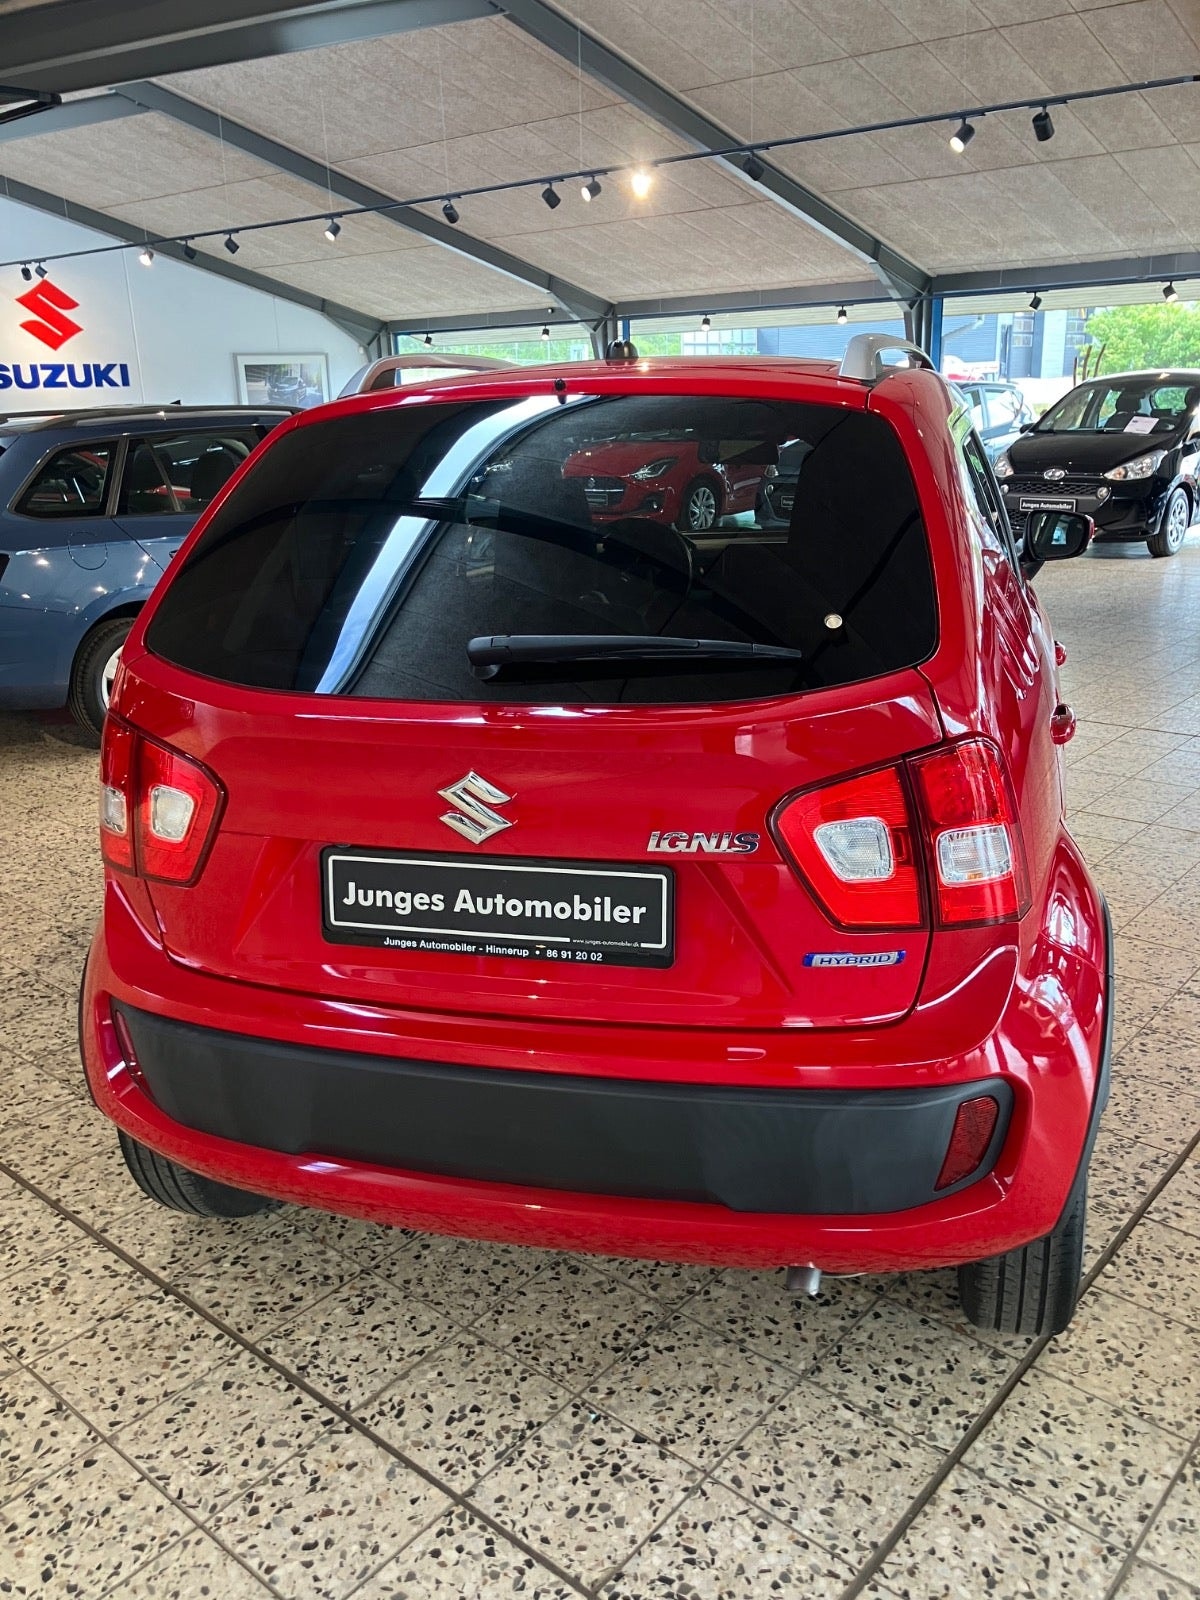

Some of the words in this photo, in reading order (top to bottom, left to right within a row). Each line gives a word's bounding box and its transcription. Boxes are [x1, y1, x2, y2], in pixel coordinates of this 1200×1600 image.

[646, 831, 761, 854] IGNIS
[342, 881, 446, 916] Junges
[453, 889, 648, 924] Automobiler
[383, 936, 418, 949] Junges
[419, 939, 477, 953] Automobiler
[485, 944, 530, 957] Hinnerup
[546, 949, 559, 959] 86
[561, 950, 572, 959] 91
[575, 951, 588, 961] 20
[590, 952, 603, 962] 02
[819, 954, 892, 965] HYBRID
